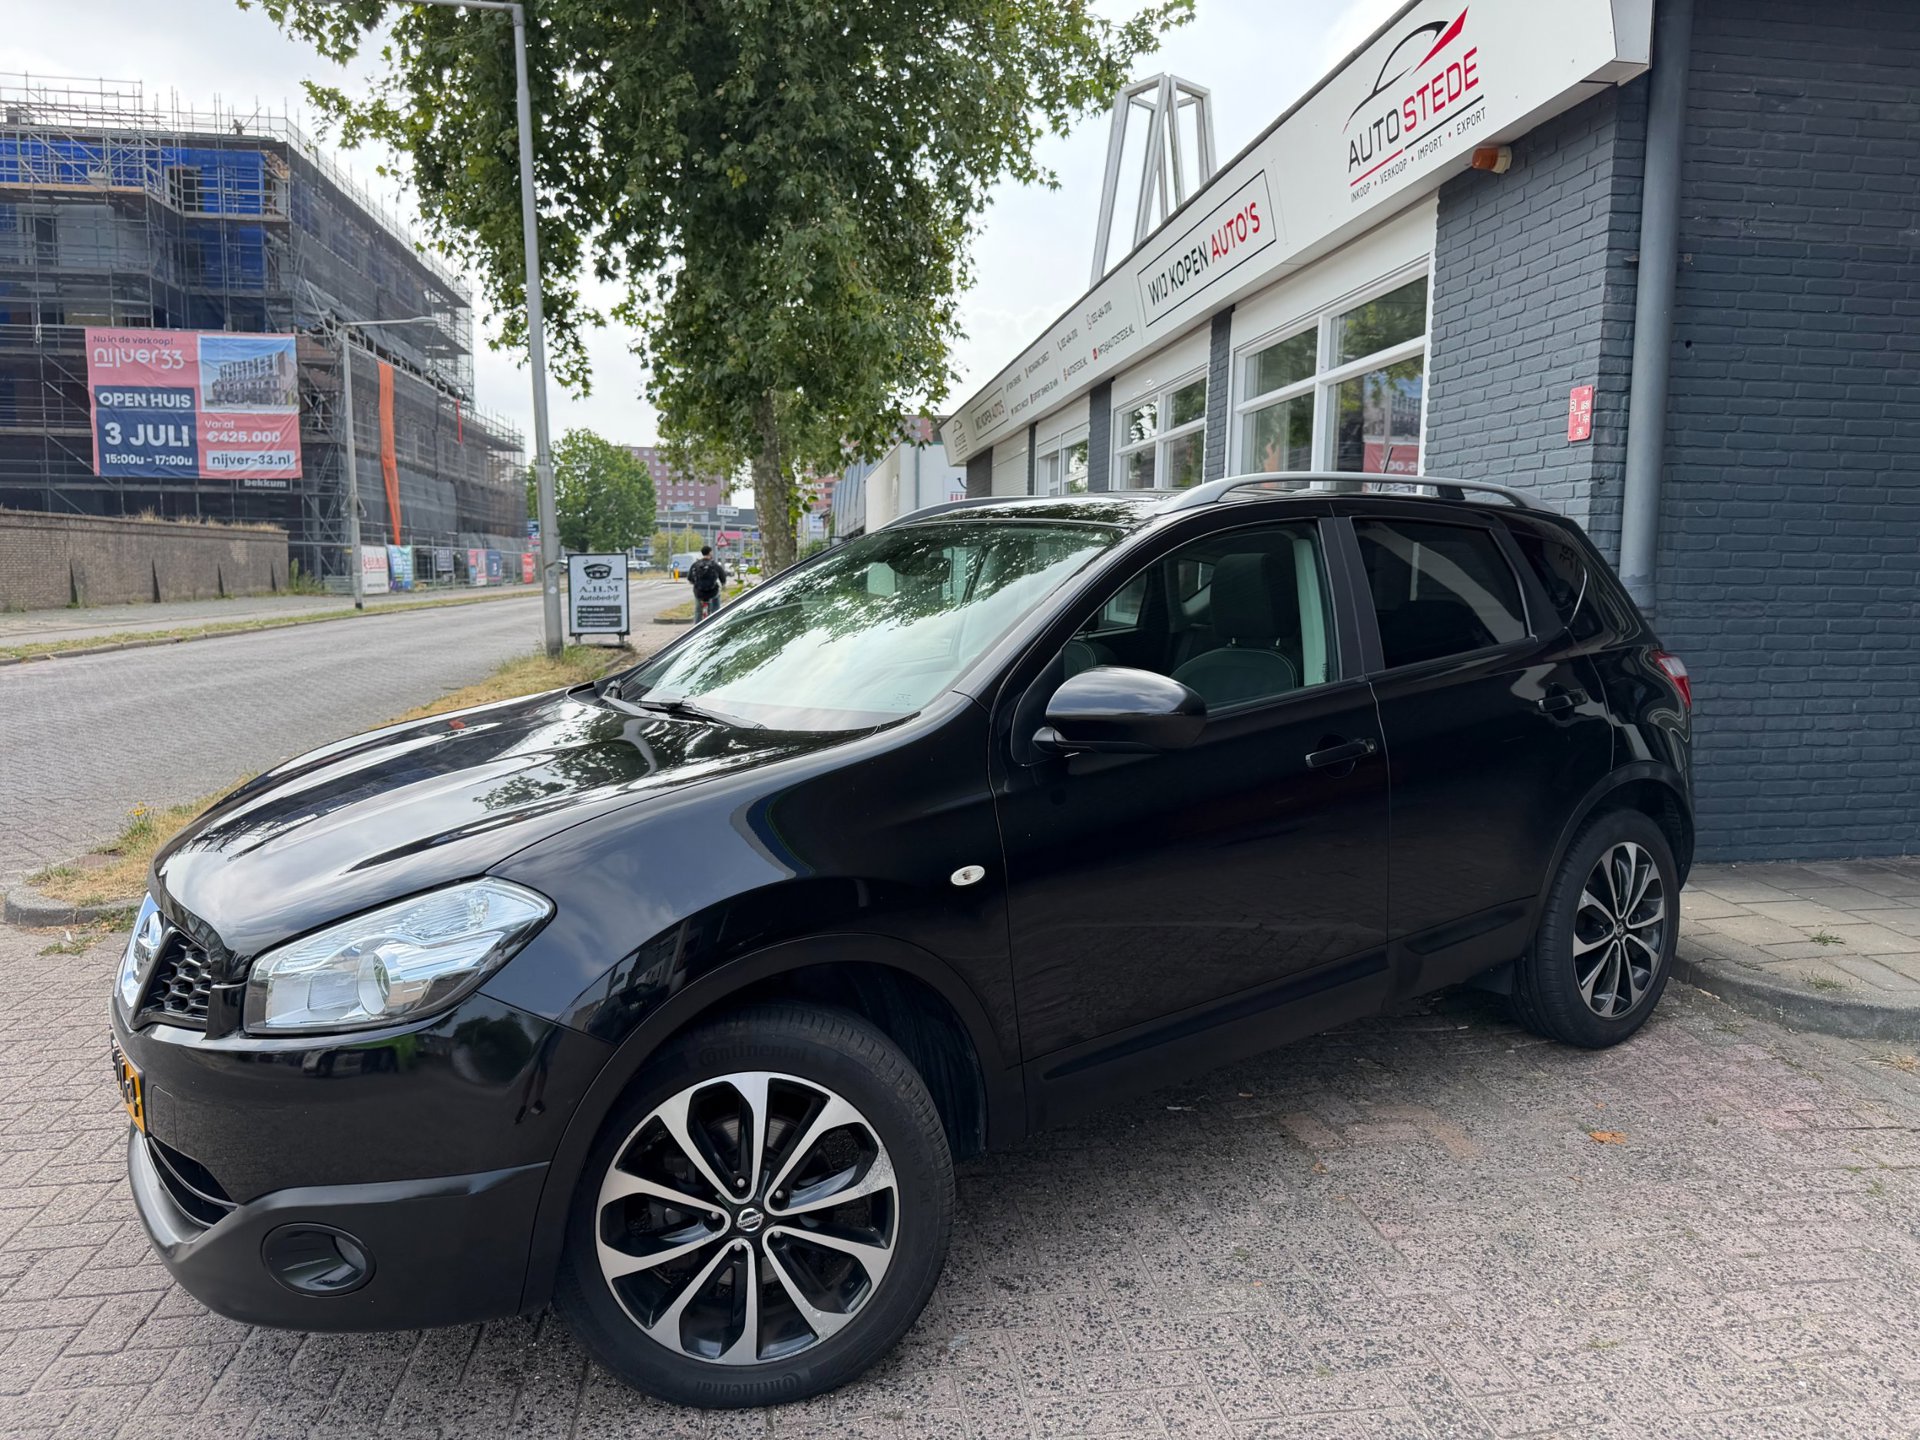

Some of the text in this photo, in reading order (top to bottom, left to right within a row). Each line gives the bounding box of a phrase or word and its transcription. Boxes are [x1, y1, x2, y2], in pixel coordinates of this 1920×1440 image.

[1350, 106, 1486, 203] INKOOP VERKOOP IMPORT EXPORT
[1147, 201, 1261, 306] WIJ KOPEN AUTO'S
[93, 335, 174, 346] Nu in de verkoop!
[98, 391, 192, 408] OPEN HUIS
[204, 420, 235, 429] Vanaf
[104, 422, 190, 447] 3 JULI
[105, 453, 144, 465] 15:00u
[155, 453, 193, 466] 17:00u
[211, 453, 291, 468] nijver-33.nl
[698, 1040, 809, 1068] Continental
